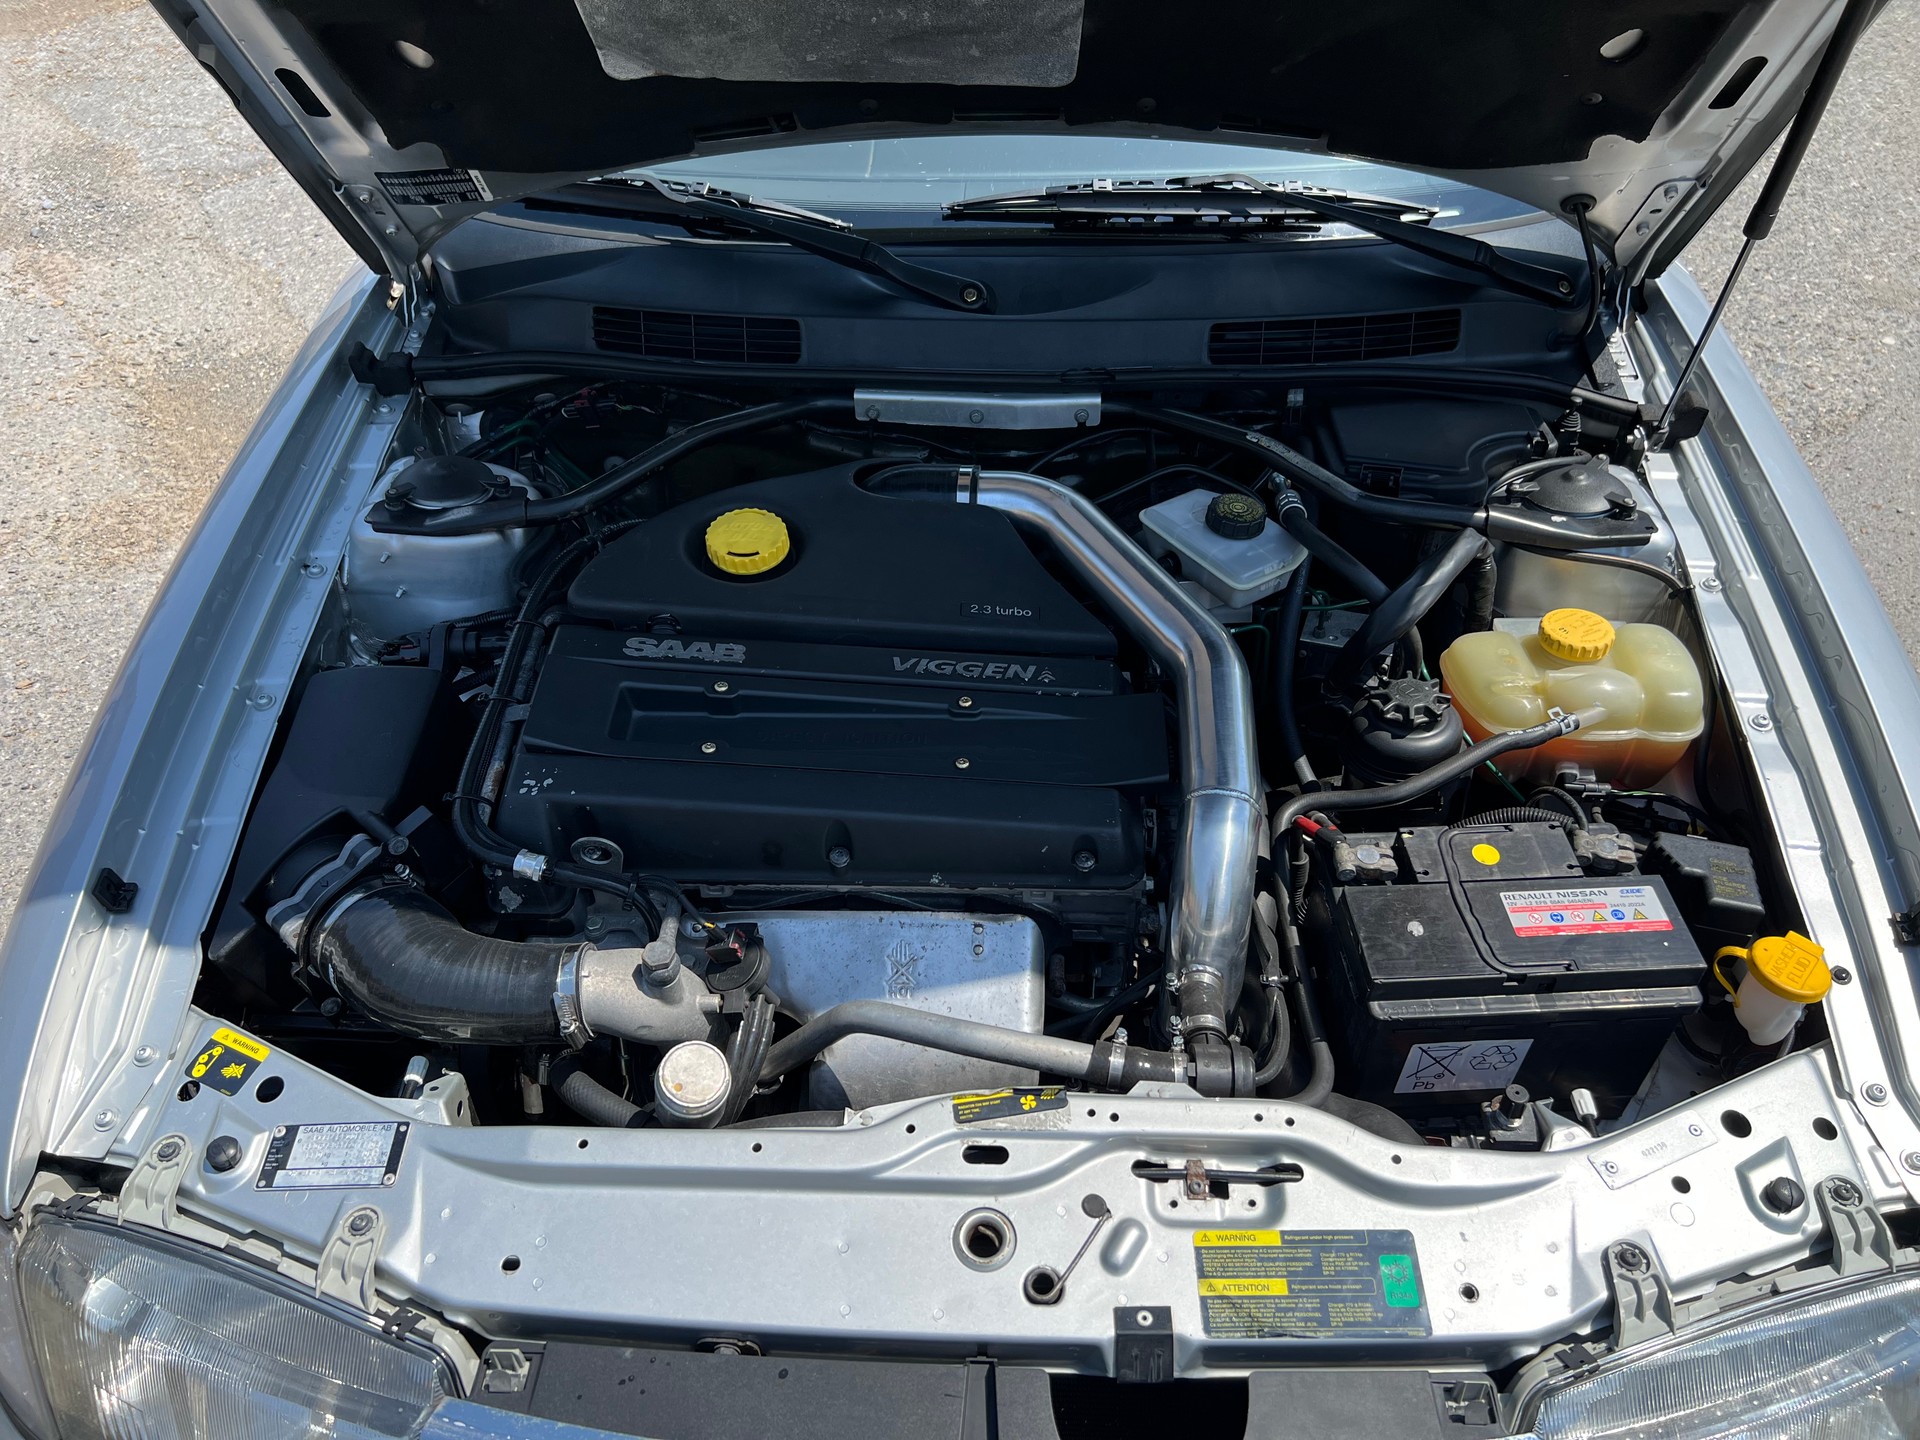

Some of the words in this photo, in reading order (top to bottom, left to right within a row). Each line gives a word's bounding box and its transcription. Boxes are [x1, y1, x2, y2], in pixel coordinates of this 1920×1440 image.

[970, 604, 992, 615] 2.3
[995, 605, 1032, 617] turbo
[622, 637, 746, 663] SAAB
[892, 656, 1037, 681] VIGGEN
[1503, 892, 1553, 901] RENAULT
[1556, 890, 1608, 899] NISSAN
[1768, 943, 1797, 979] WASHER
[1786, 956, 1811, 985] FLUID
[231, 1037, 260, 1054] WARNING
[1412, 1081, 1435, 1090] Pb
[303, 1126, 325, 1134] SAAB
[326, 1124, 379, 1133] AUTOMOBILE
[380, 1124, 393, 1132] AB
[1215, 1234, 1257, 1242] WARNING
[1221, 1283, 1270, 1292] ATTENTION
